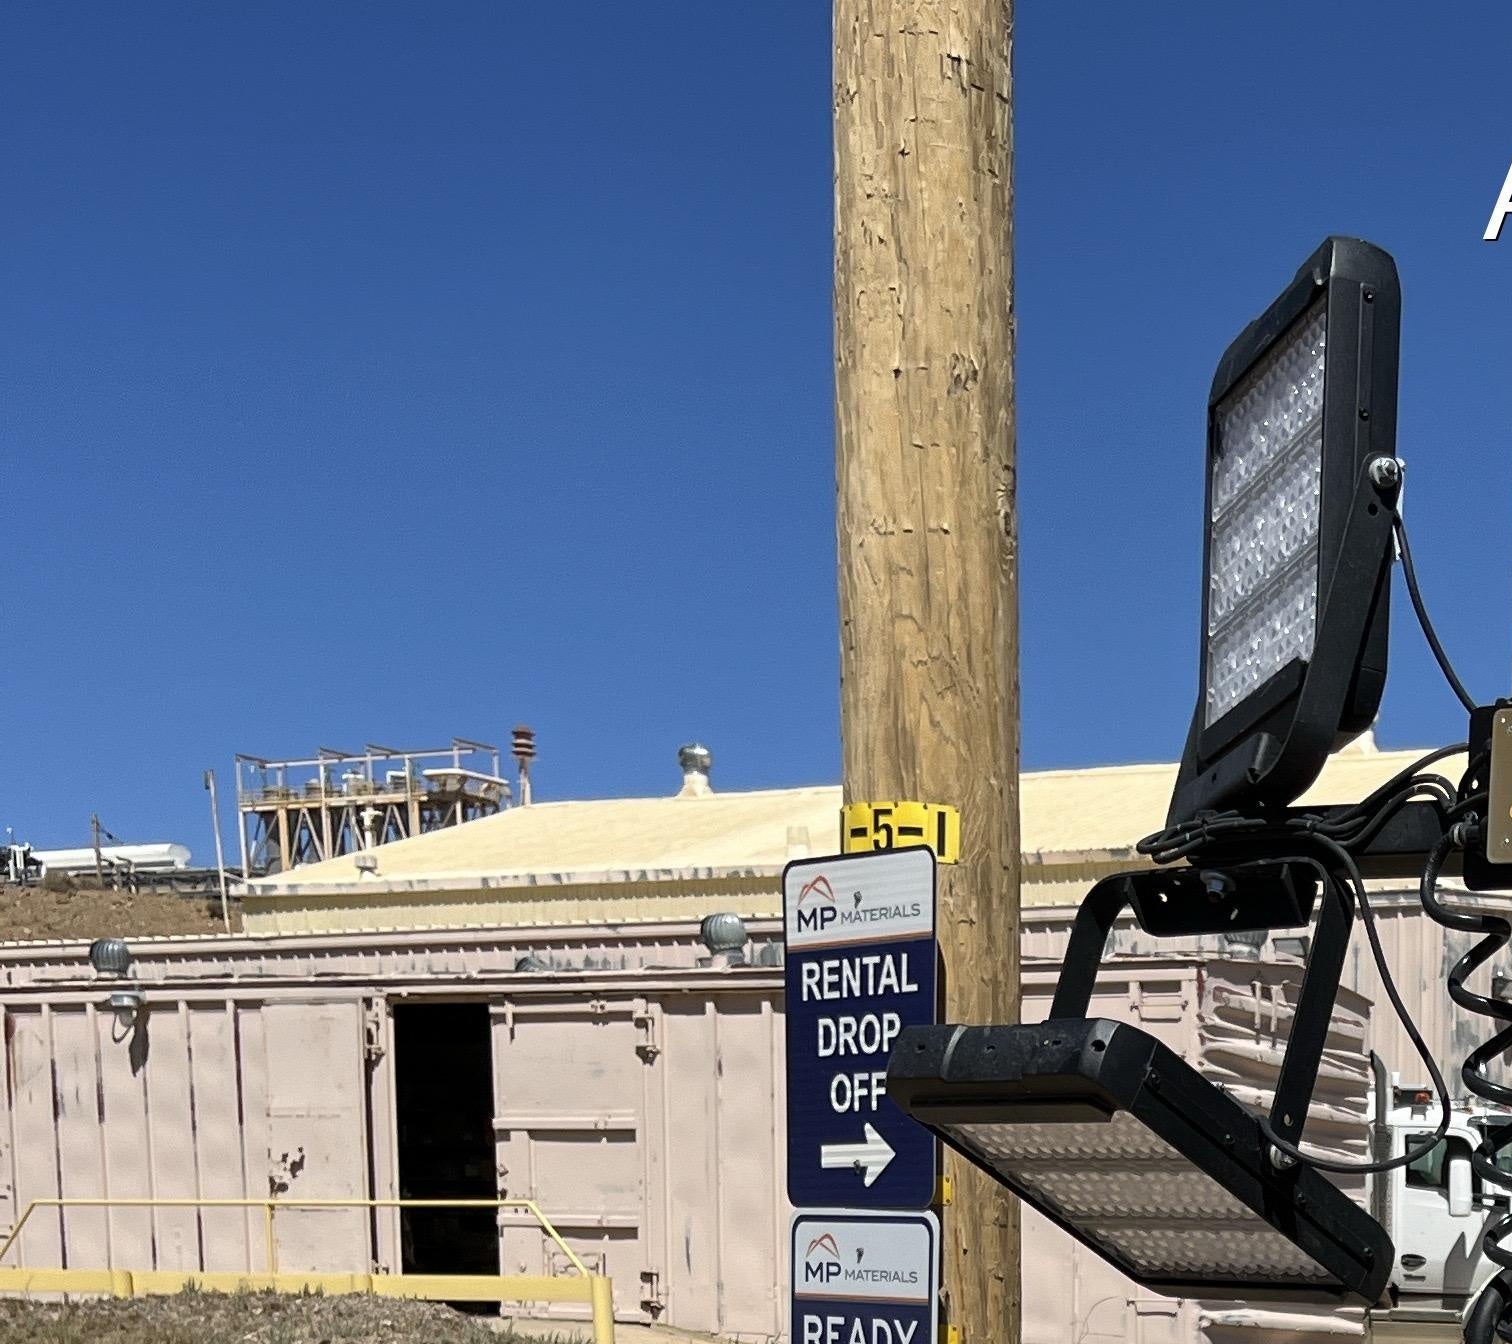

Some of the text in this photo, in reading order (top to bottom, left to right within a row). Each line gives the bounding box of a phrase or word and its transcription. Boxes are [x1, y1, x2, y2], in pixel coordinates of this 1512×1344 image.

[797, 903, 921, 933] MP MATERIALS
[801, 952, 919, 1002] RENTAL
[817, 1012, 902, 1058] DROP
[830, 1071, 888, 1114] OFF
[804, 1260, 919, 1284] MP MATERIALS
